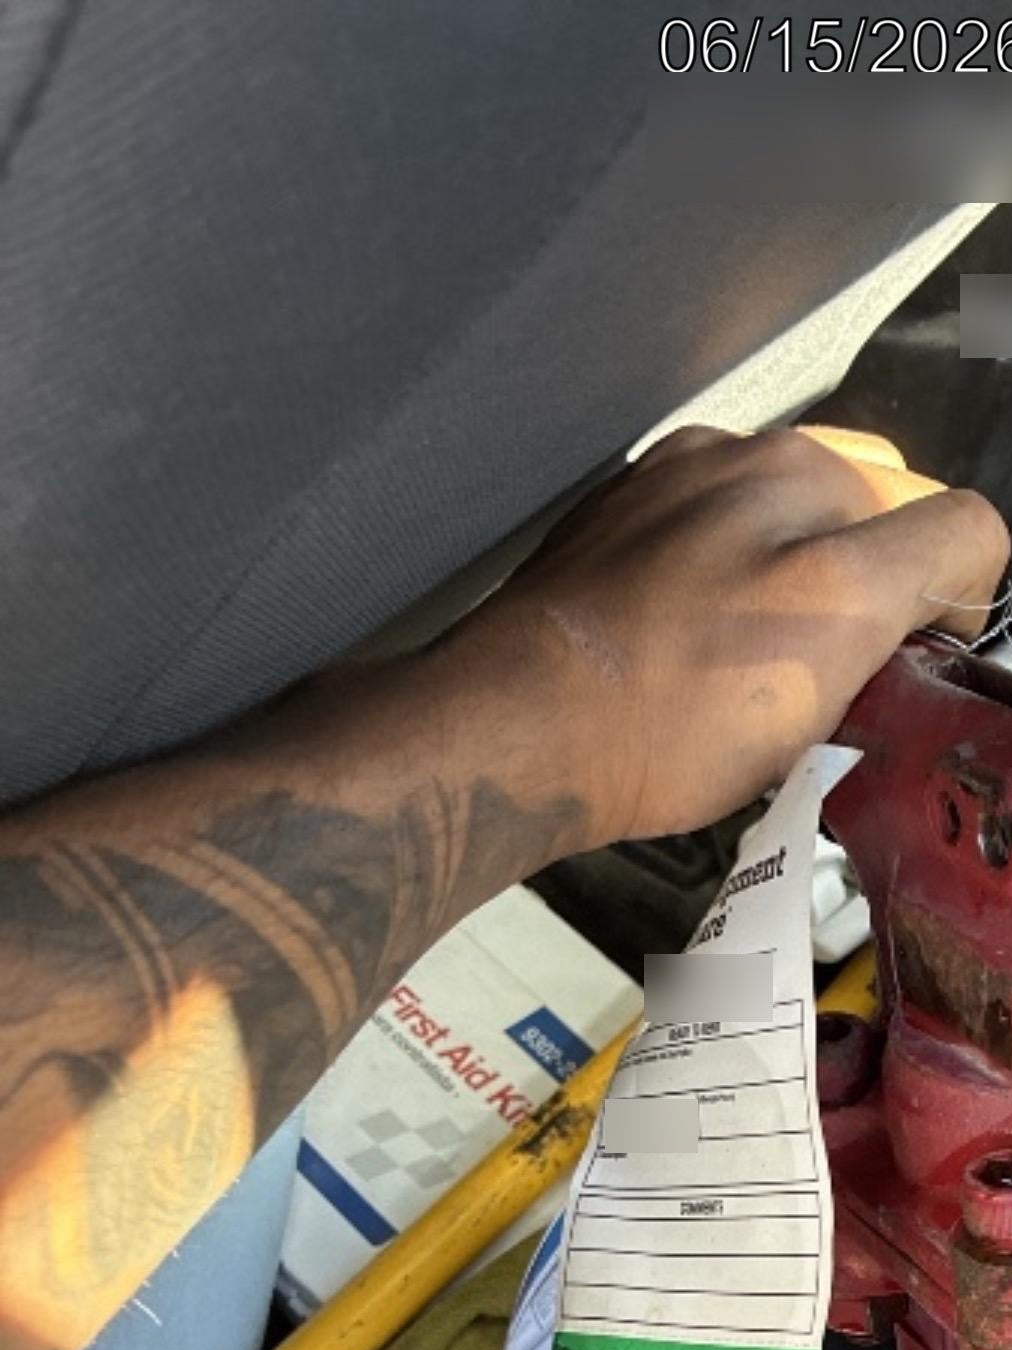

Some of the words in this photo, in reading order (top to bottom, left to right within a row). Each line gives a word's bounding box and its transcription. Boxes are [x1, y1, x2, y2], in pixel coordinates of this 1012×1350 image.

[390, 984, 451, 1048] First
[437, 1045, 500, 1091] Aid
[486, 1083, 533, 1129] Ki
